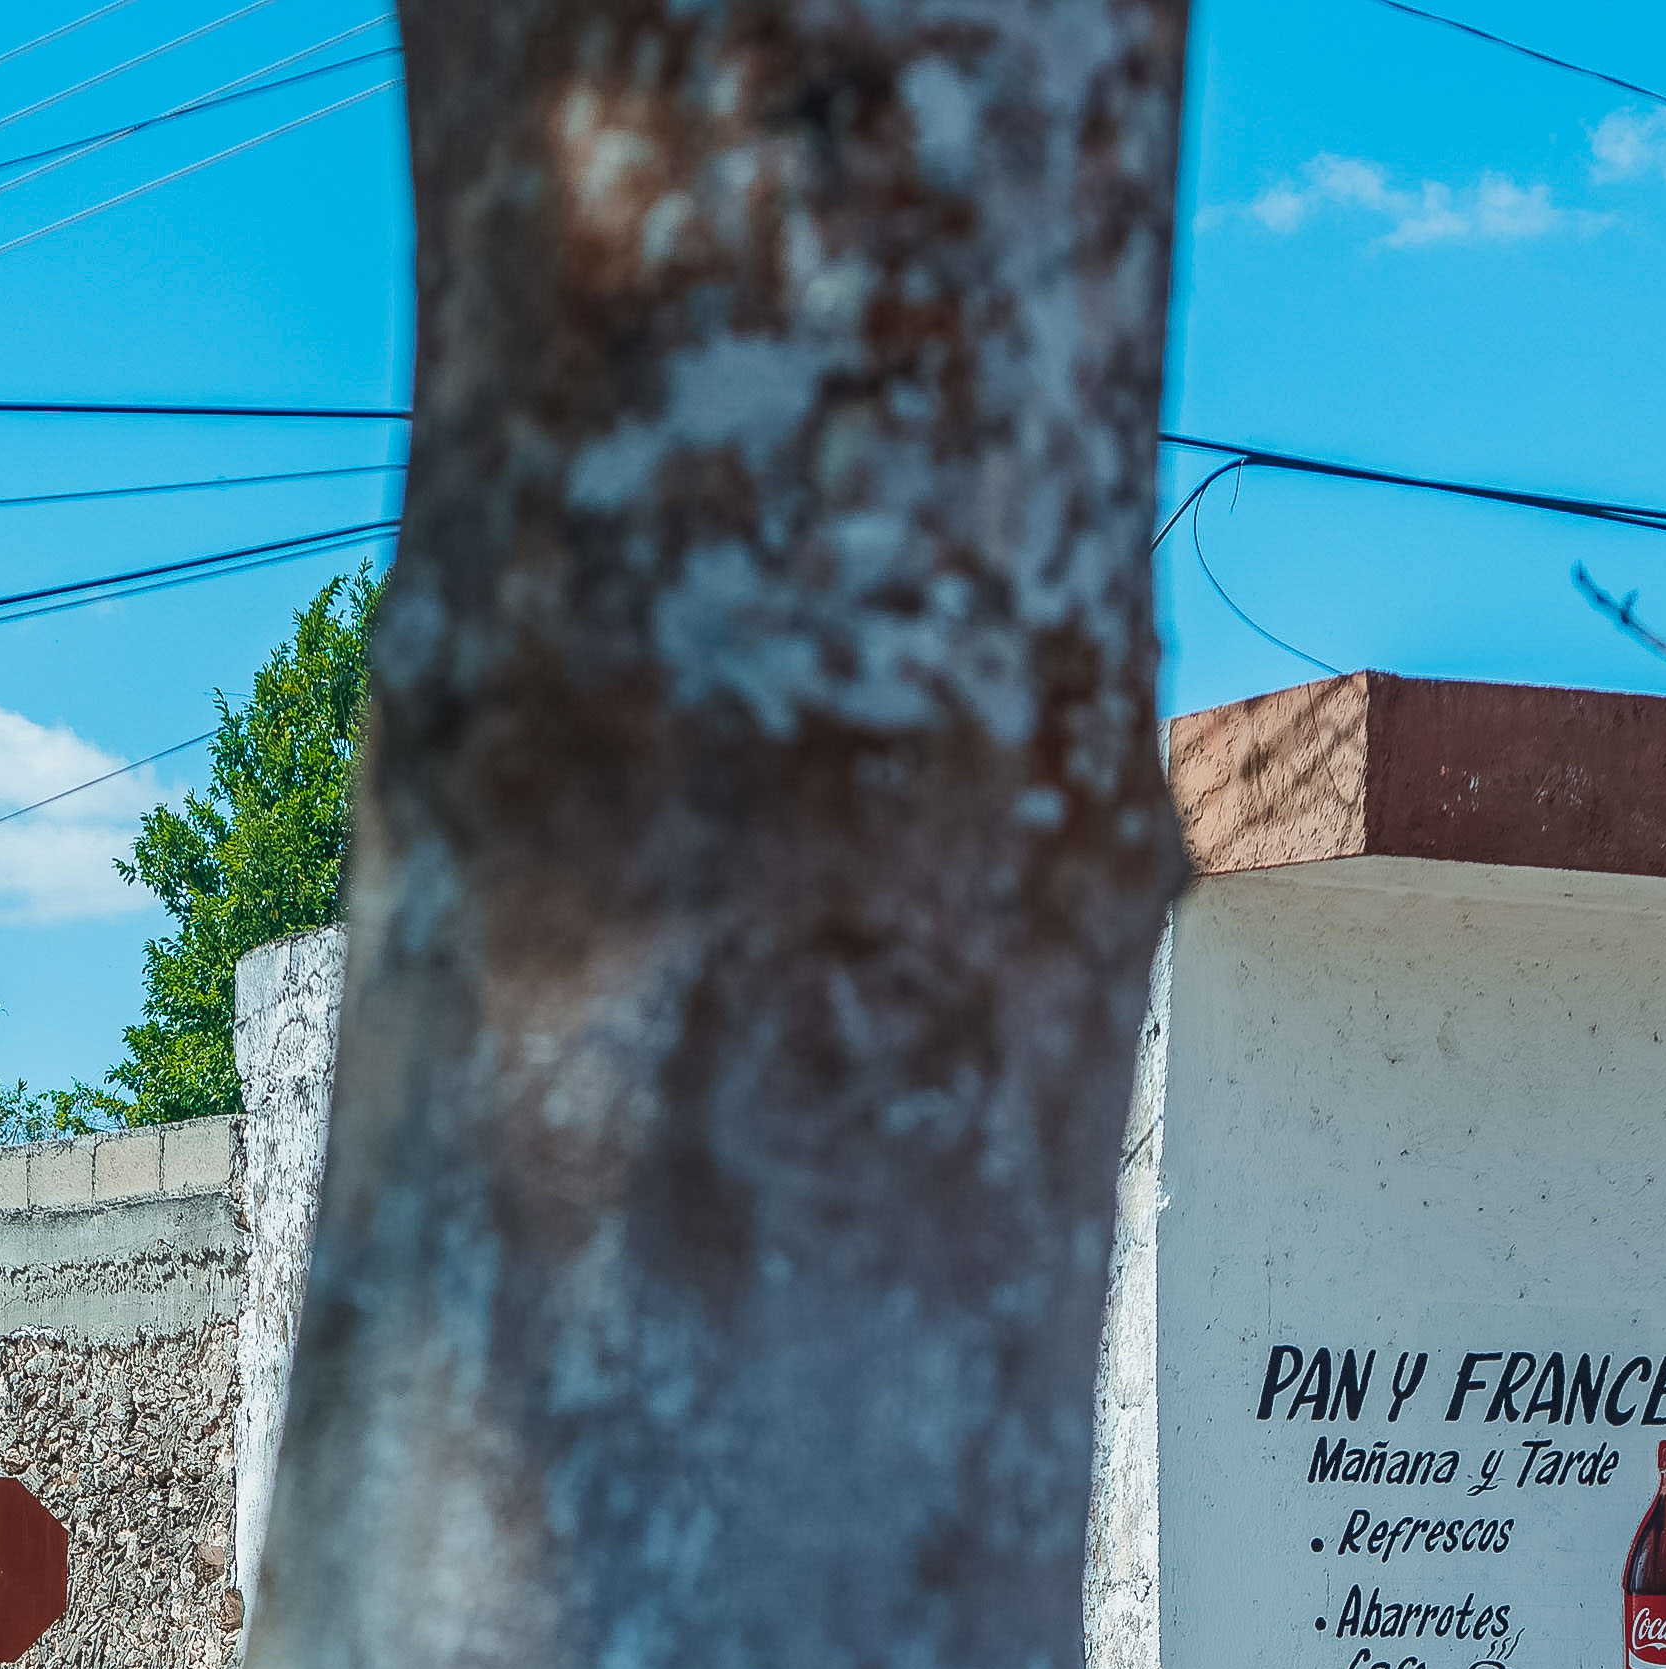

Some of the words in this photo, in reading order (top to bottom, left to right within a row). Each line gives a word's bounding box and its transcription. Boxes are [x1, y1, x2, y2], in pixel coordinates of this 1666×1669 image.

[1256, 1344, 1377, 1422] PAN
[1387, 1351, 1429, 1423] Y
[1307, 1435, 1460, 1486] Mañana
[1466, 1449, 1505, 1497] y
[1516, 1439, 1620, 1489] Tarde
[1337, 1509, 1515, 1561] Refrescos
[1335, 1583, 1511, 1641] Abarrotes
